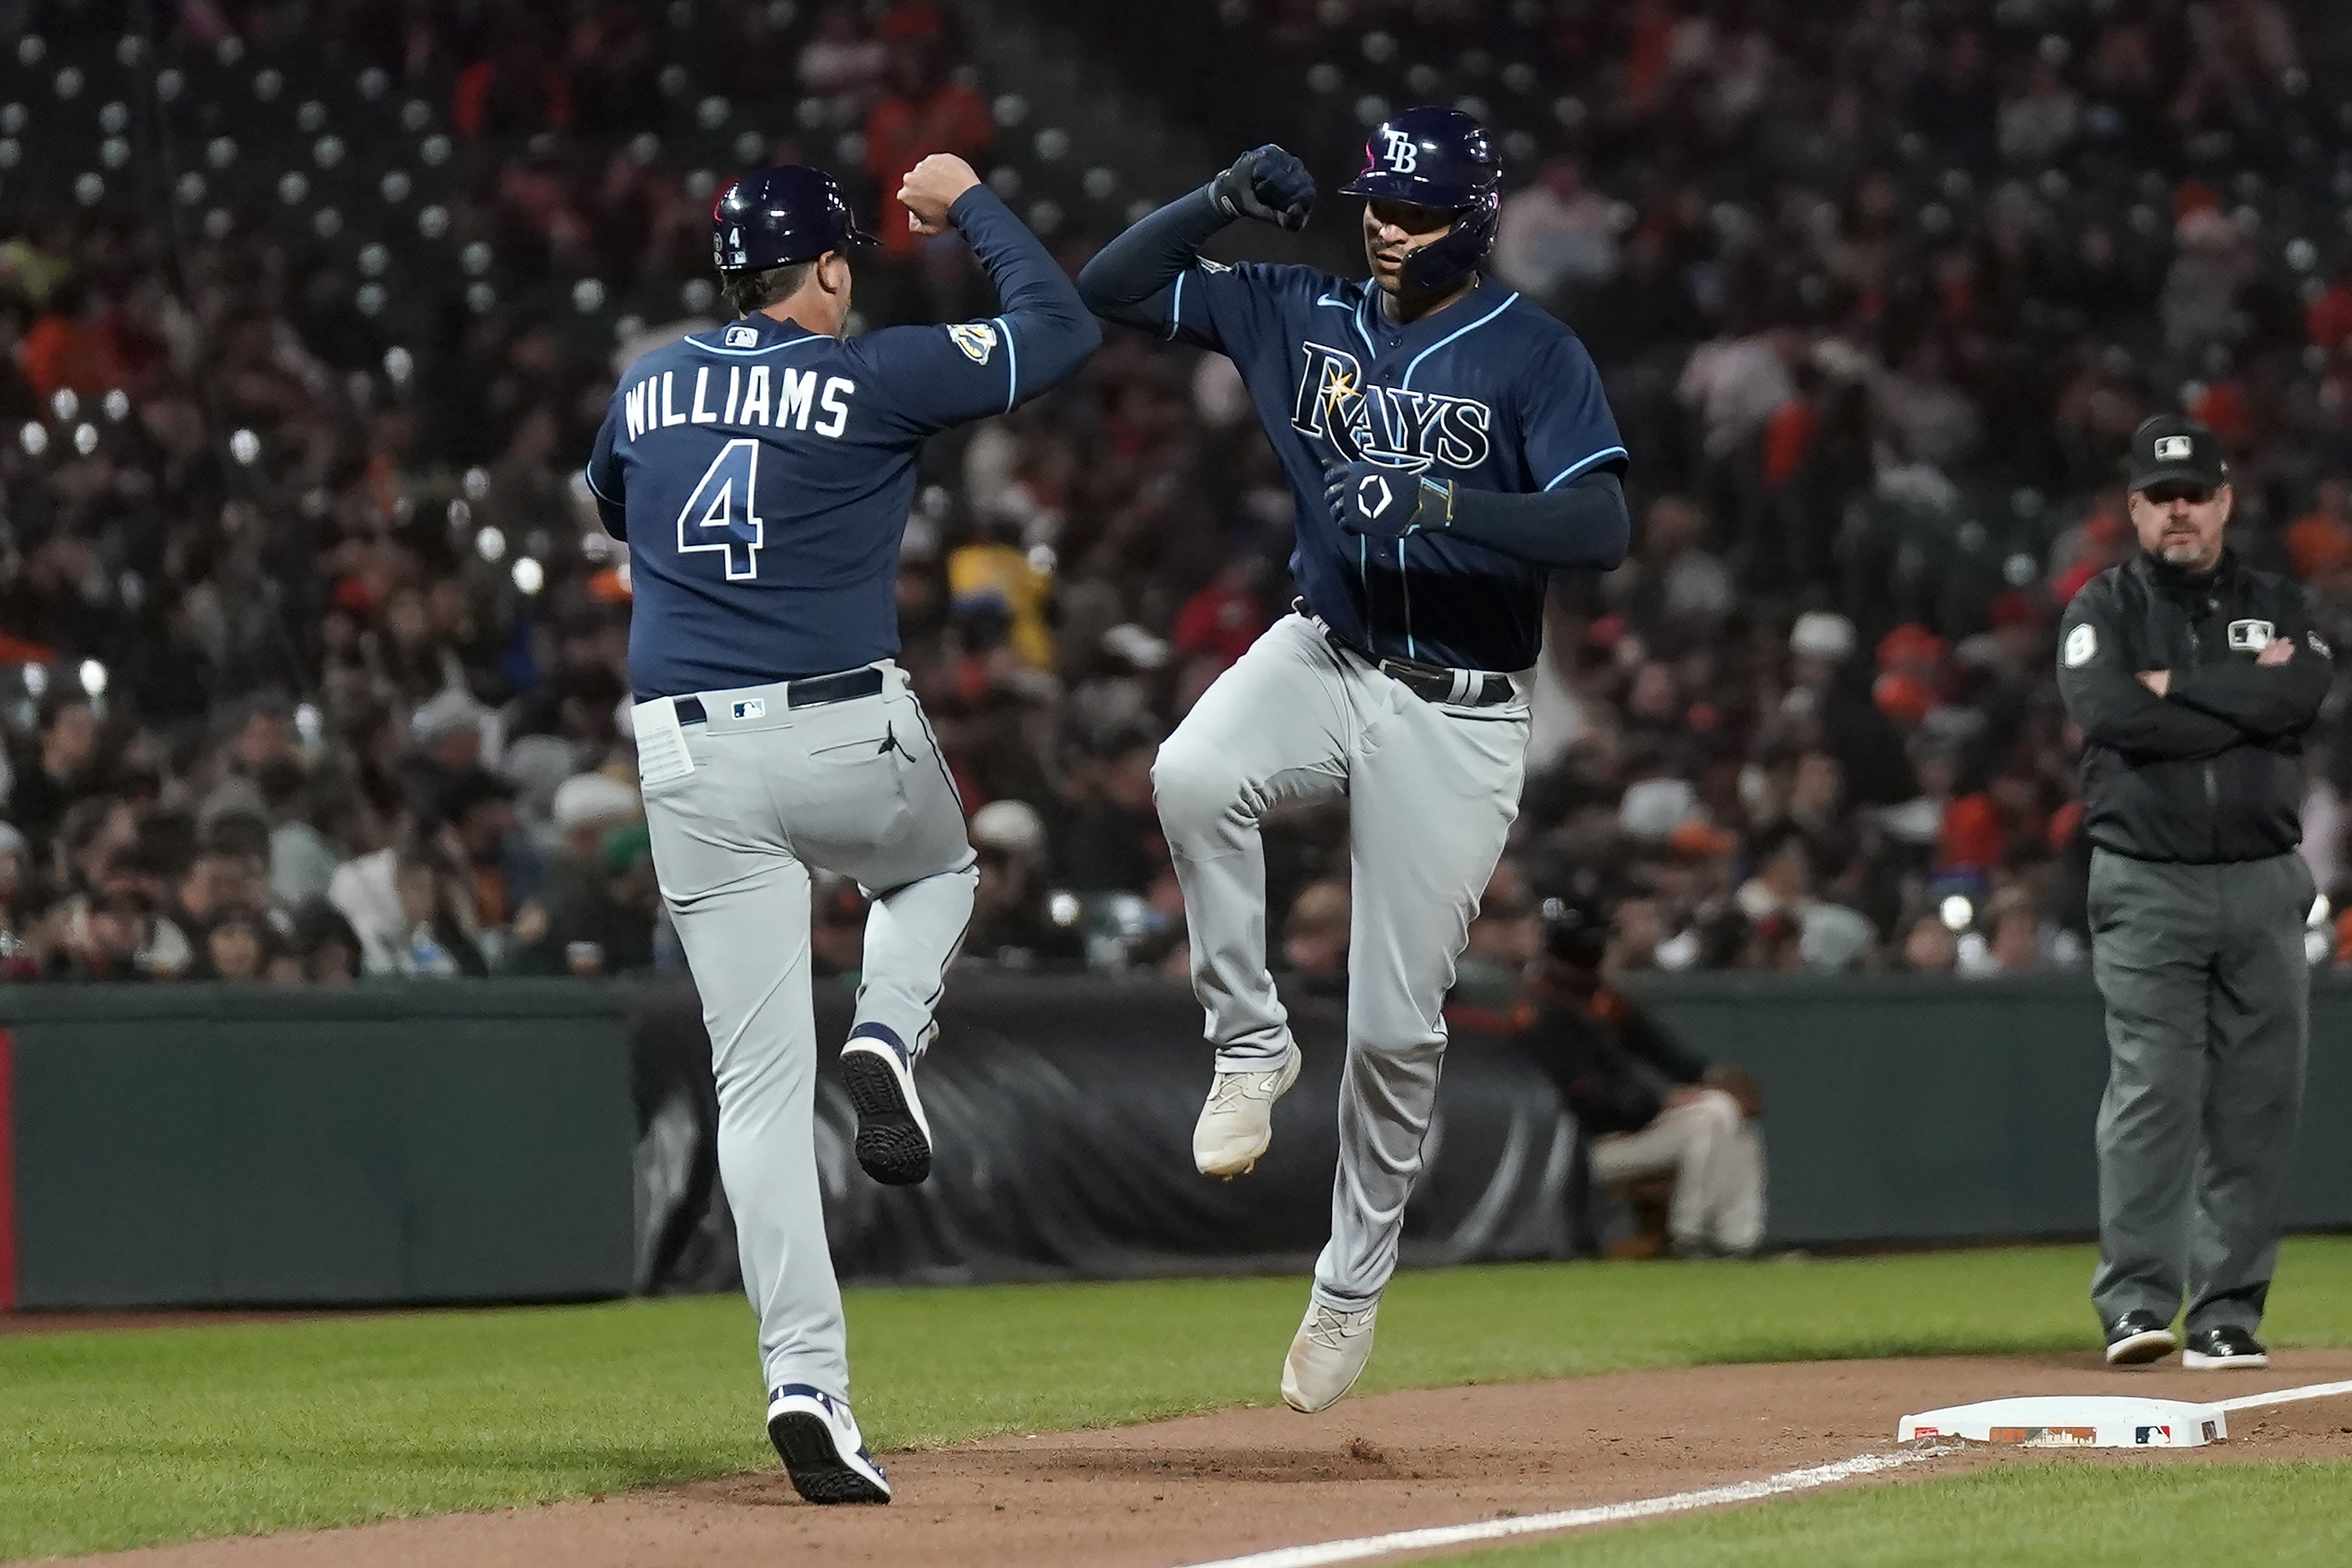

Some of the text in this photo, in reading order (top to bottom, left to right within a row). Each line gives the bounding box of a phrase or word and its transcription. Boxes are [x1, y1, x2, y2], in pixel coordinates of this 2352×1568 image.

[1383, 129, 1417, 173] TB
[729, 227, 740, 249] 4
[626, 365, 855, 443] WILLIAMS
[1291, 340, 1491, 475] RAYS
[677, 438, 764, 581] 4
